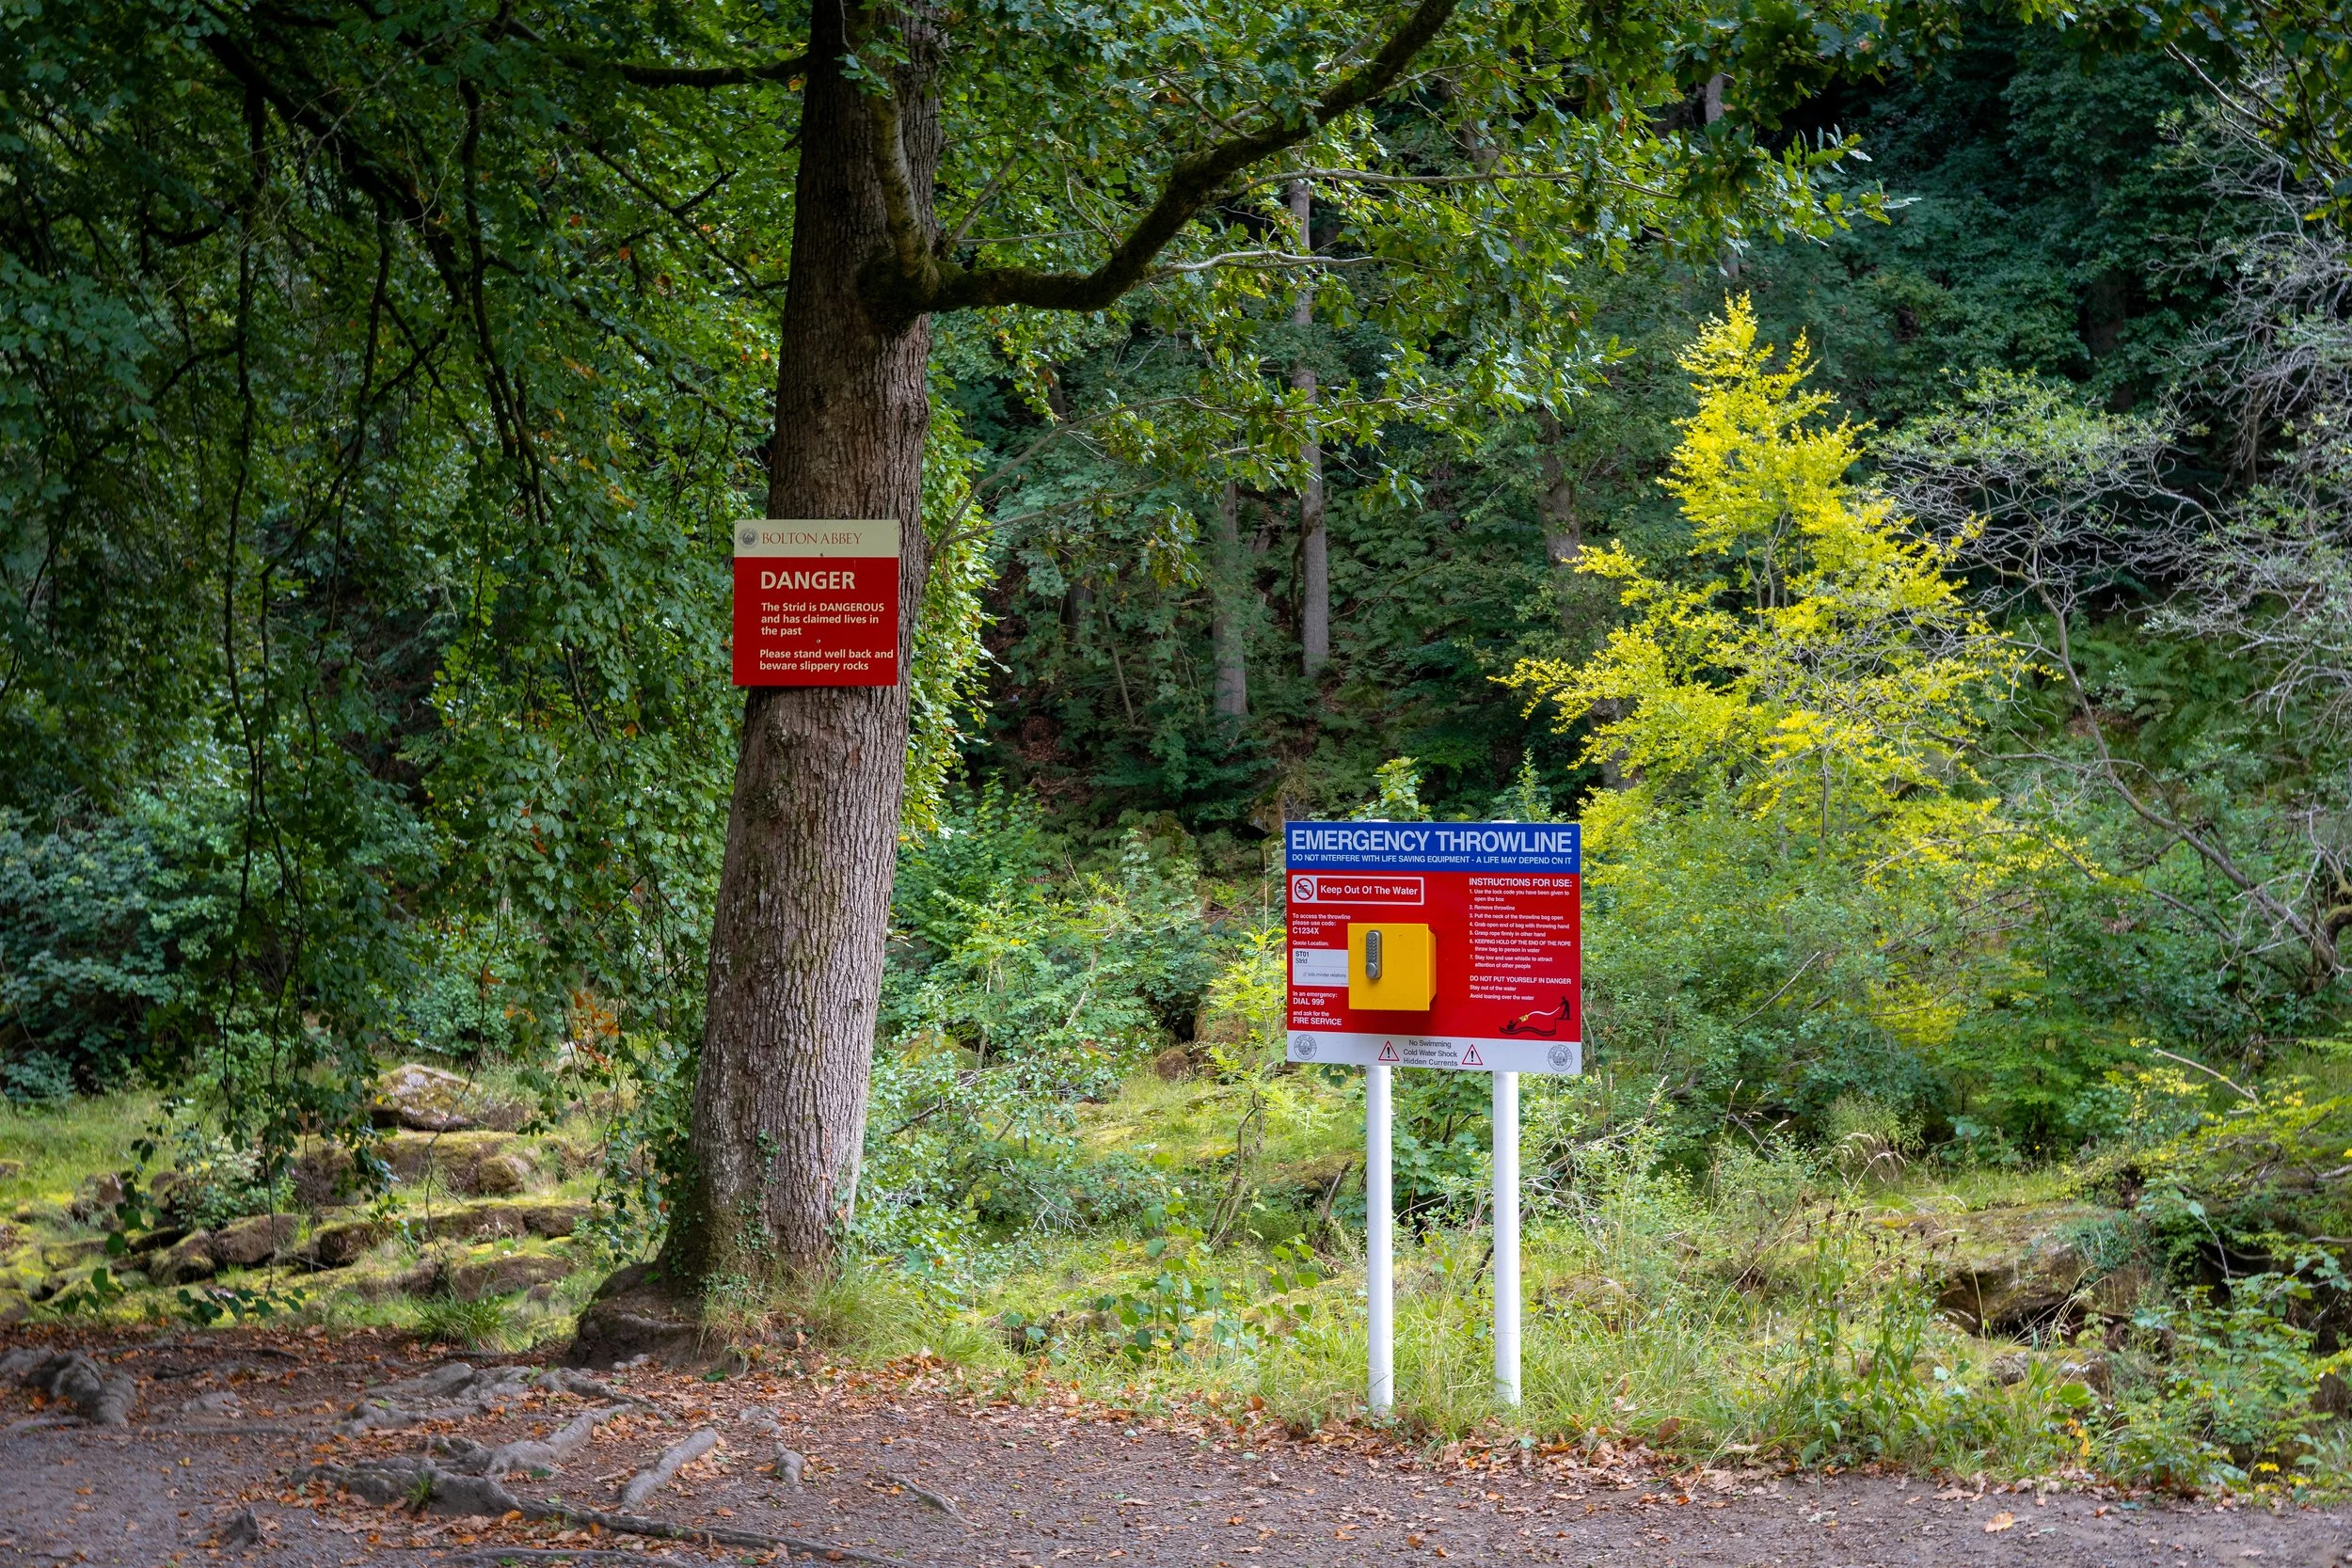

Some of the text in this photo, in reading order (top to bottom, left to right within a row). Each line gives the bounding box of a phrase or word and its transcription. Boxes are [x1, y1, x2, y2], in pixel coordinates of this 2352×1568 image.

[762, 533, 817, 544] BOLTON
[820, 533, 862, 544] ABBEY
[761, 571, 855, 589] DANGER
[761, 603, 884, 611] The Strid is DANGEROUS
[761, 615, 879, 623] and has claimed lives in
[761, 627, 802, 637] the past
[760, 649, 893, 658] Please stand well back and
[760, 661, 868, 672] beware slippery rocks
[1292, 830, 1572, 852] EMERGENCY THROWLINE
[1321, 885, 1341, 895] Keep
[1420, 1040, 1451, 1048] Swimming
